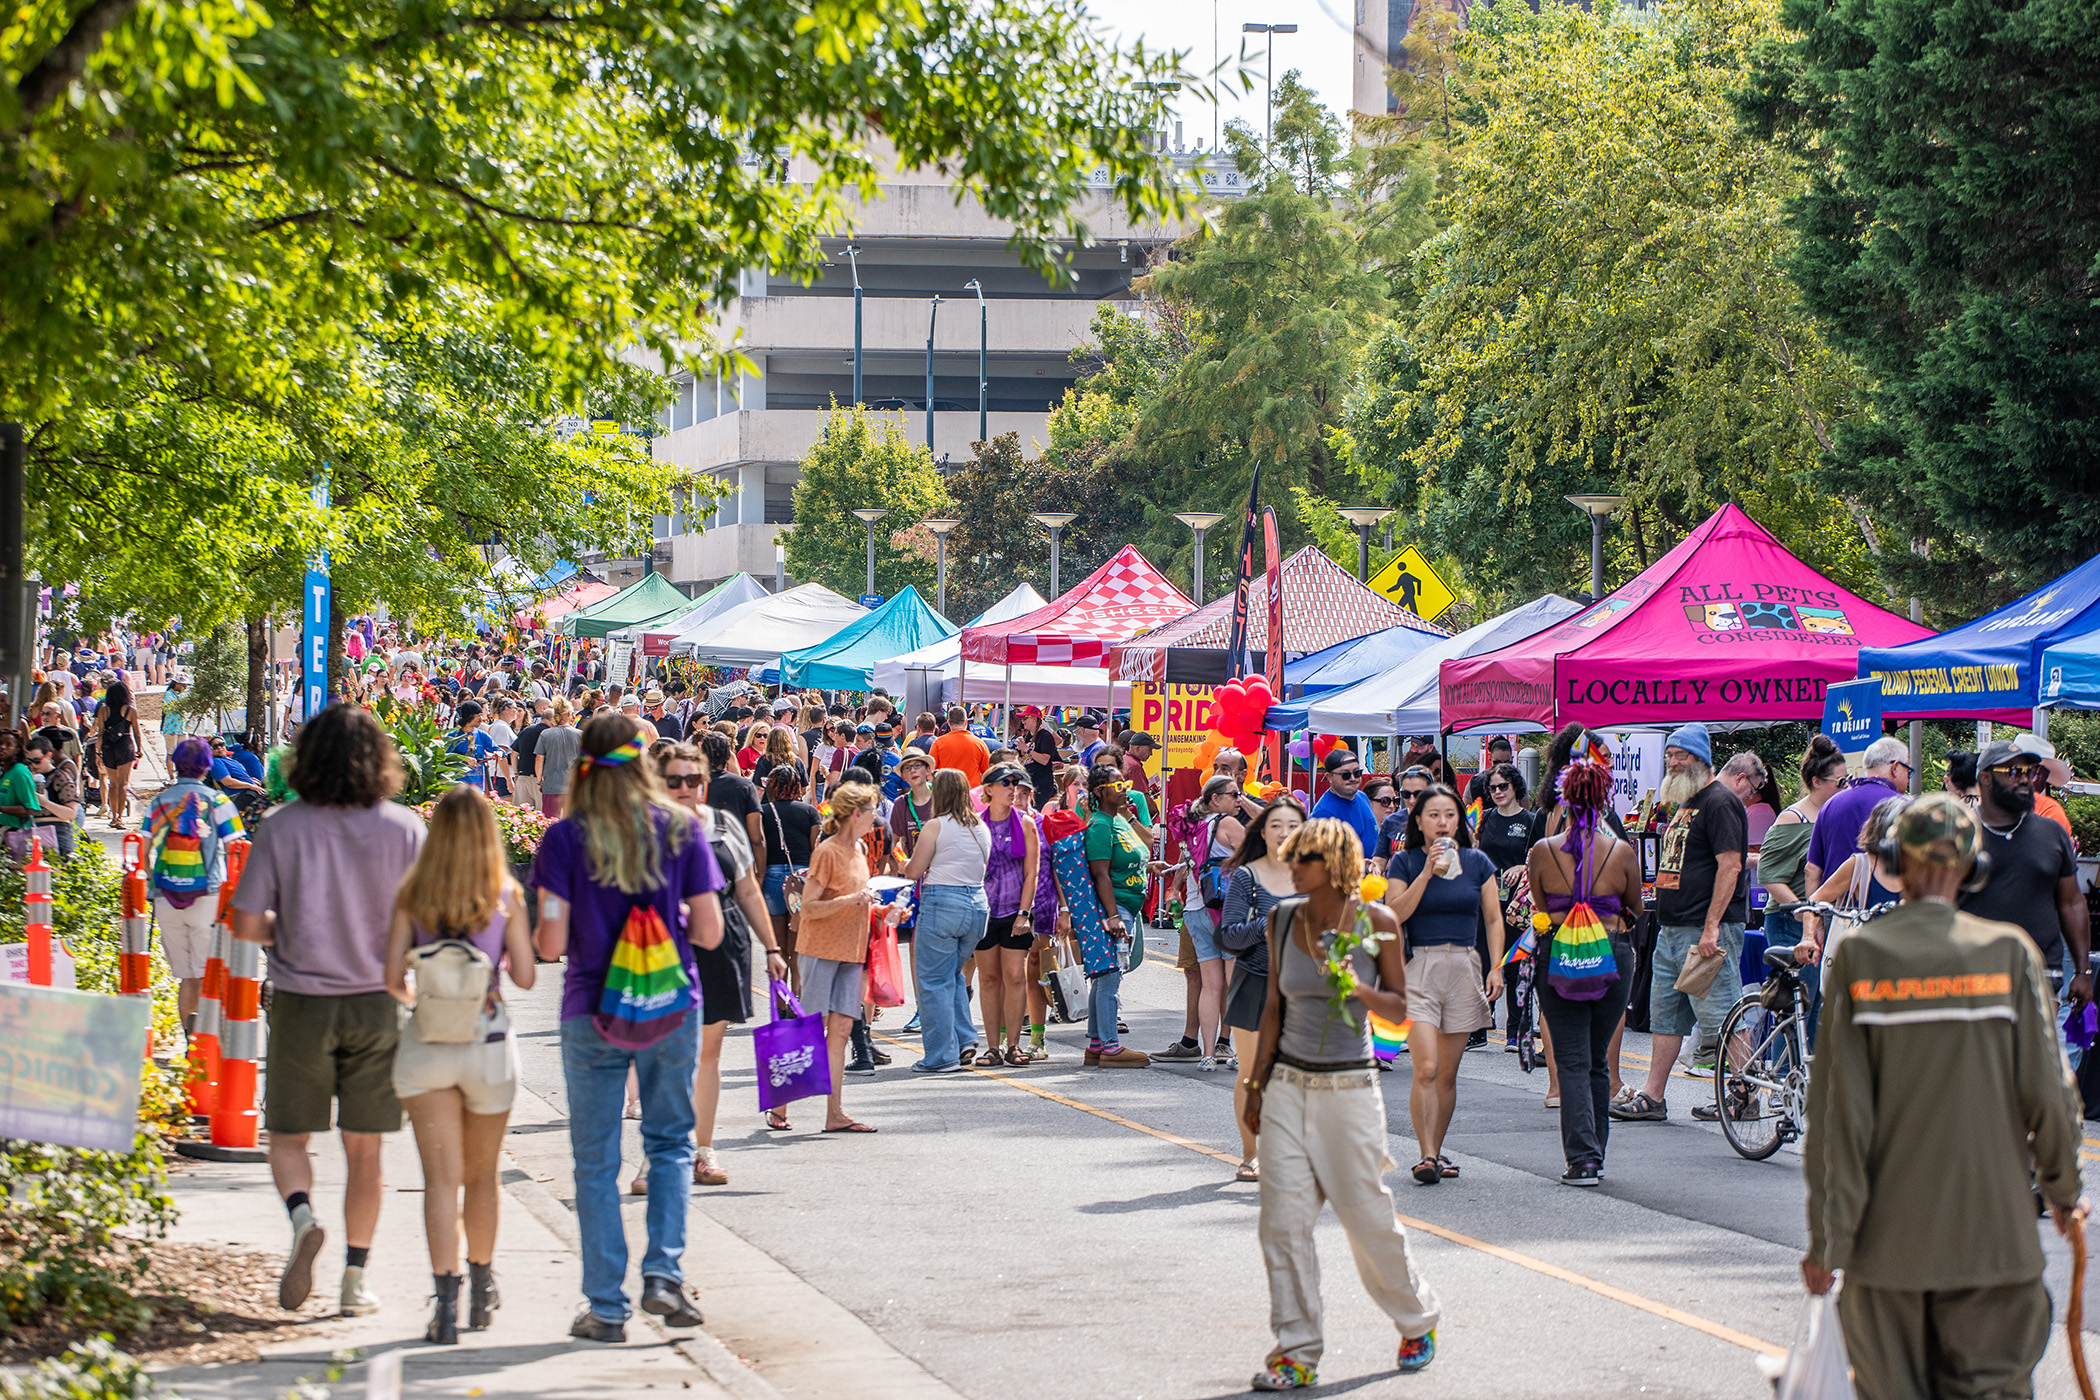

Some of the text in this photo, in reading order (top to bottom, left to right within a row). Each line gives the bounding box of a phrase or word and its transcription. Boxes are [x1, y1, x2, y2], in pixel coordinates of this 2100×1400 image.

[1680, 583, 1840, 608] ALL PETS
[1091, 605, 1190, 618] SHEETZ
[1977, 608, 2075, 633] TRULIANT
[1696, 631, 1862, 647] CONSIDERED
[1567, 679, 1710, 705] LOCALLY
[1719, 677, 1829, 704] OWNED
[1911, 667, 1953, 695] FEDERAL
[1950, 665, 1985, 693] CREDIT
[1985, 662, 2019, 691] UNION
[1443, 680, 1552, 706] WWW.ALLPETSCONSIDERED.COM
[1831, 717, 1871, 734] TRULIANT
[1849, 972, 2013, 1002] MARINES
